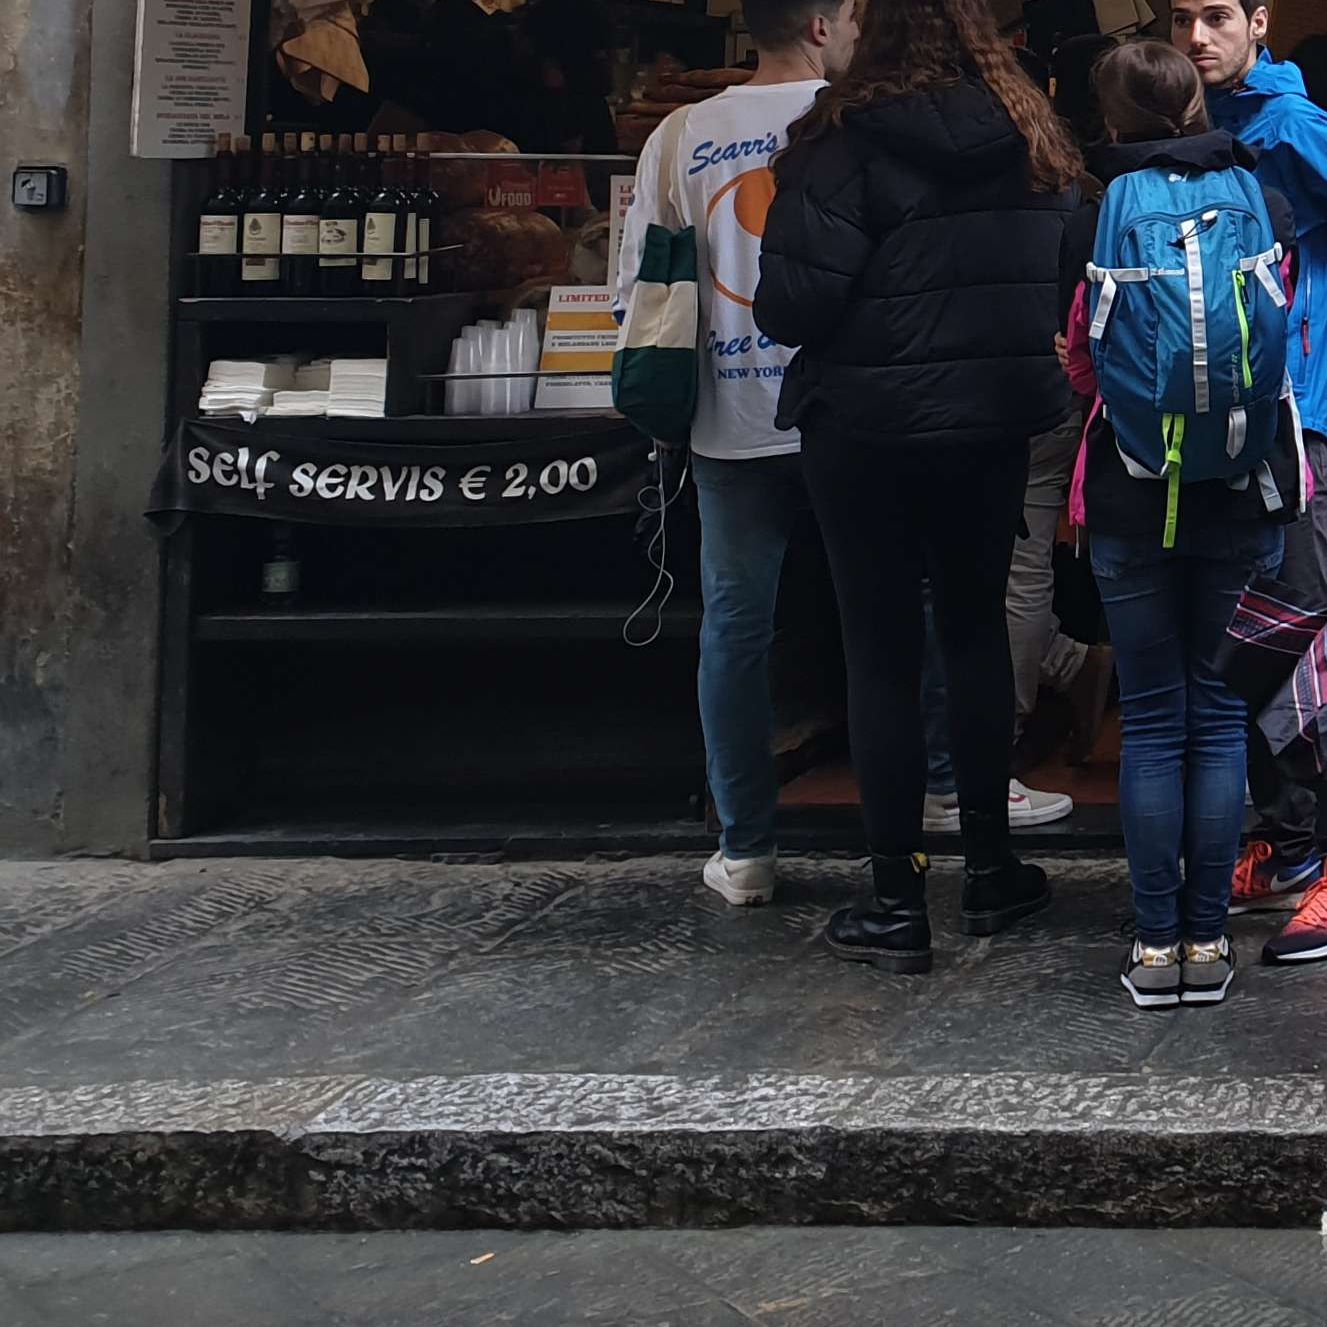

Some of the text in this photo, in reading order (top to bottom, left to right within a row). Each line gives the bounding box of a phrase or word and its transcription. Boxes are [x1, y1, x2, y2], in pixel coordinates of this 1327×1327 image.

[689, 133, 779, 175] Scarr's
[558, 294, 610, 303] LIMITED
[717, 366, 784, 380] NEW YOR
[187, 446, 599, 503] SELF SERVIS € 2,00
